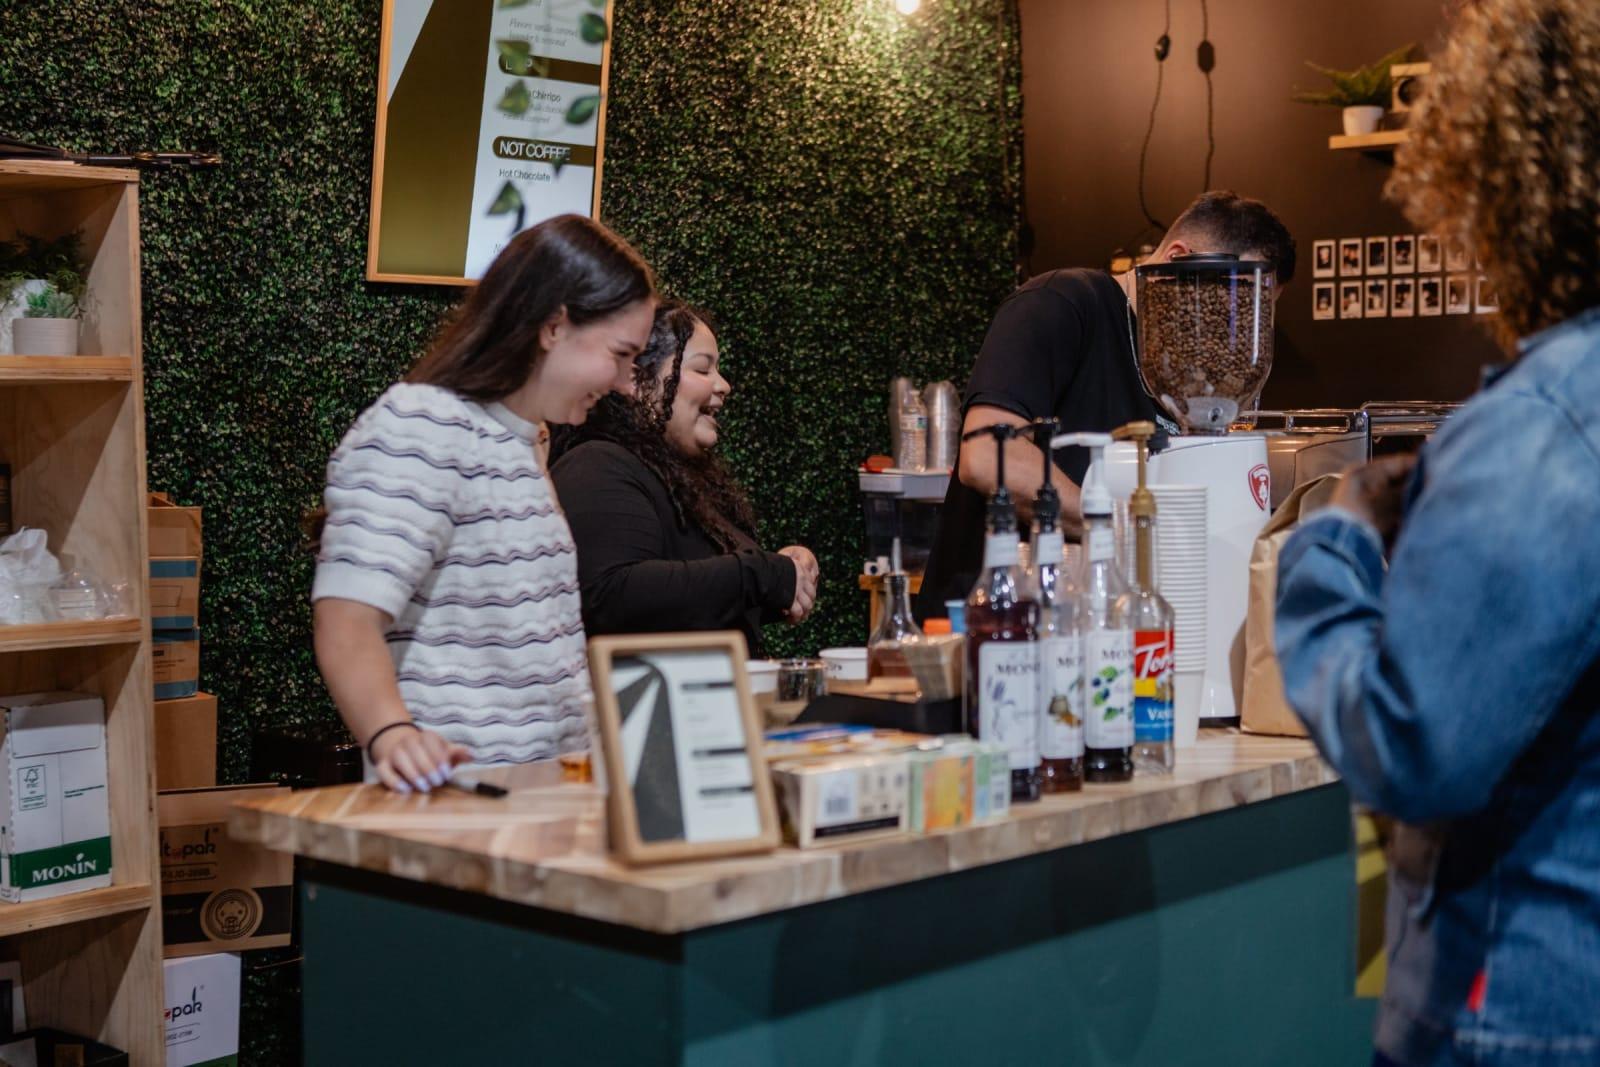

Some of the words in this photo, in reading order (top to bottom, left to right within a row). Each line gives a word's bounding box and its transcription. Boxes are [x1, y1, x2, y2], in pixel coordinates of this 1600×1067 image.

[500, 141, 525, 156] NOT
[499, 168, 513, 178] Hot
[514, 169, 551, 182] Chocolate
[32, 853, 97, 883] MONIN
